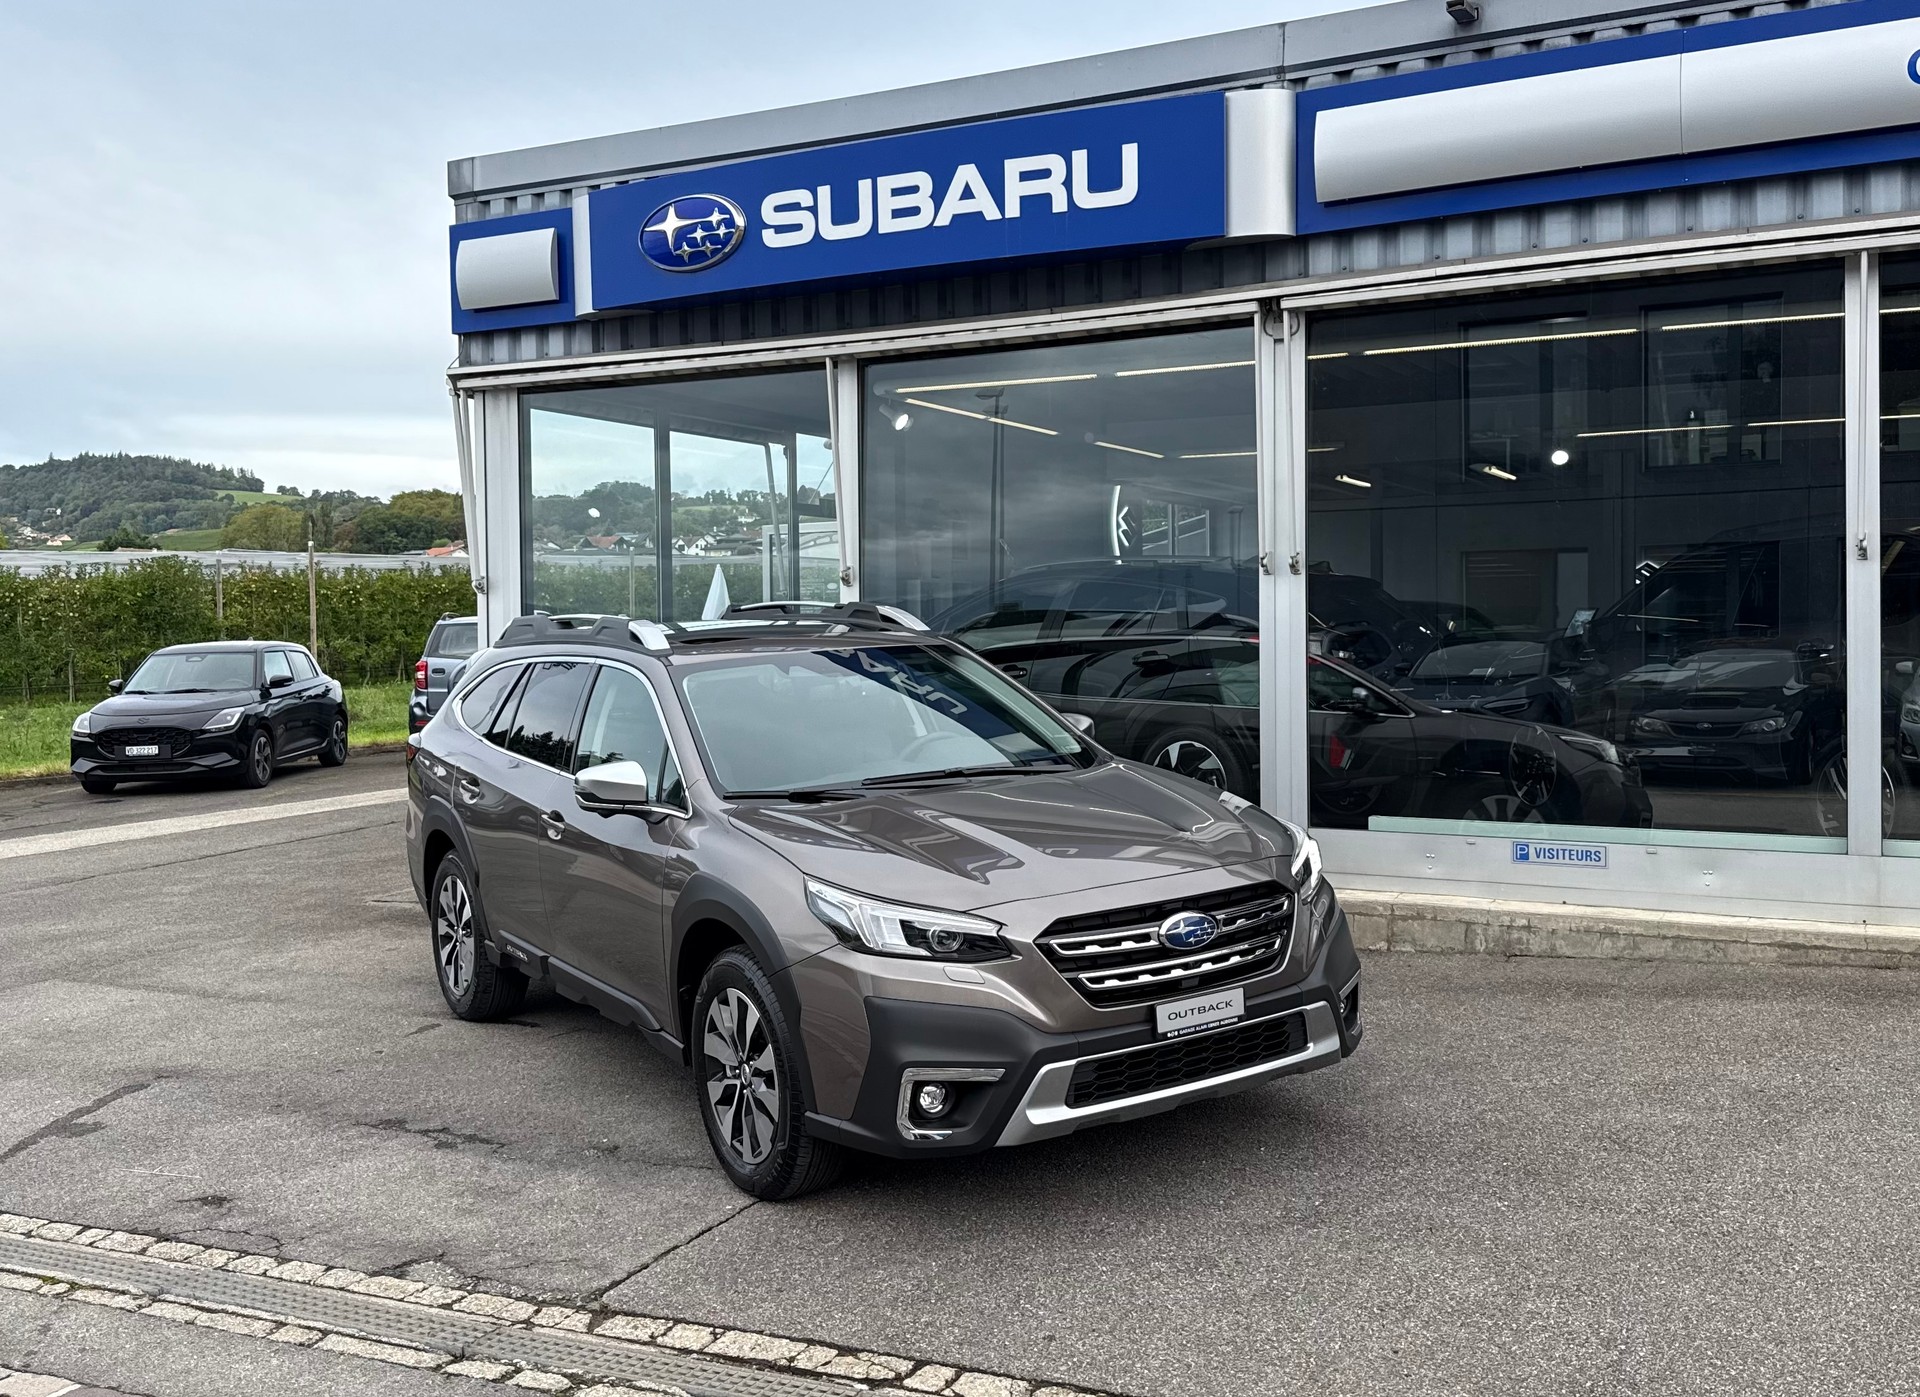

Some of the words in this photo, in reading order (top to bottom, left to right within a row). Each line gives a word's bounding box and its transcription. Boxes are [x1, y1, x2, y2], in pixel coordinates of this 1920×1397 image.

[761, 142, 1139, 248] SUBARU
[1516, 845, 1529, 860] P
[1534, 847, 1602, 863] VISITEURS
[1168, 999, 1234, 1021] OUTBACK
